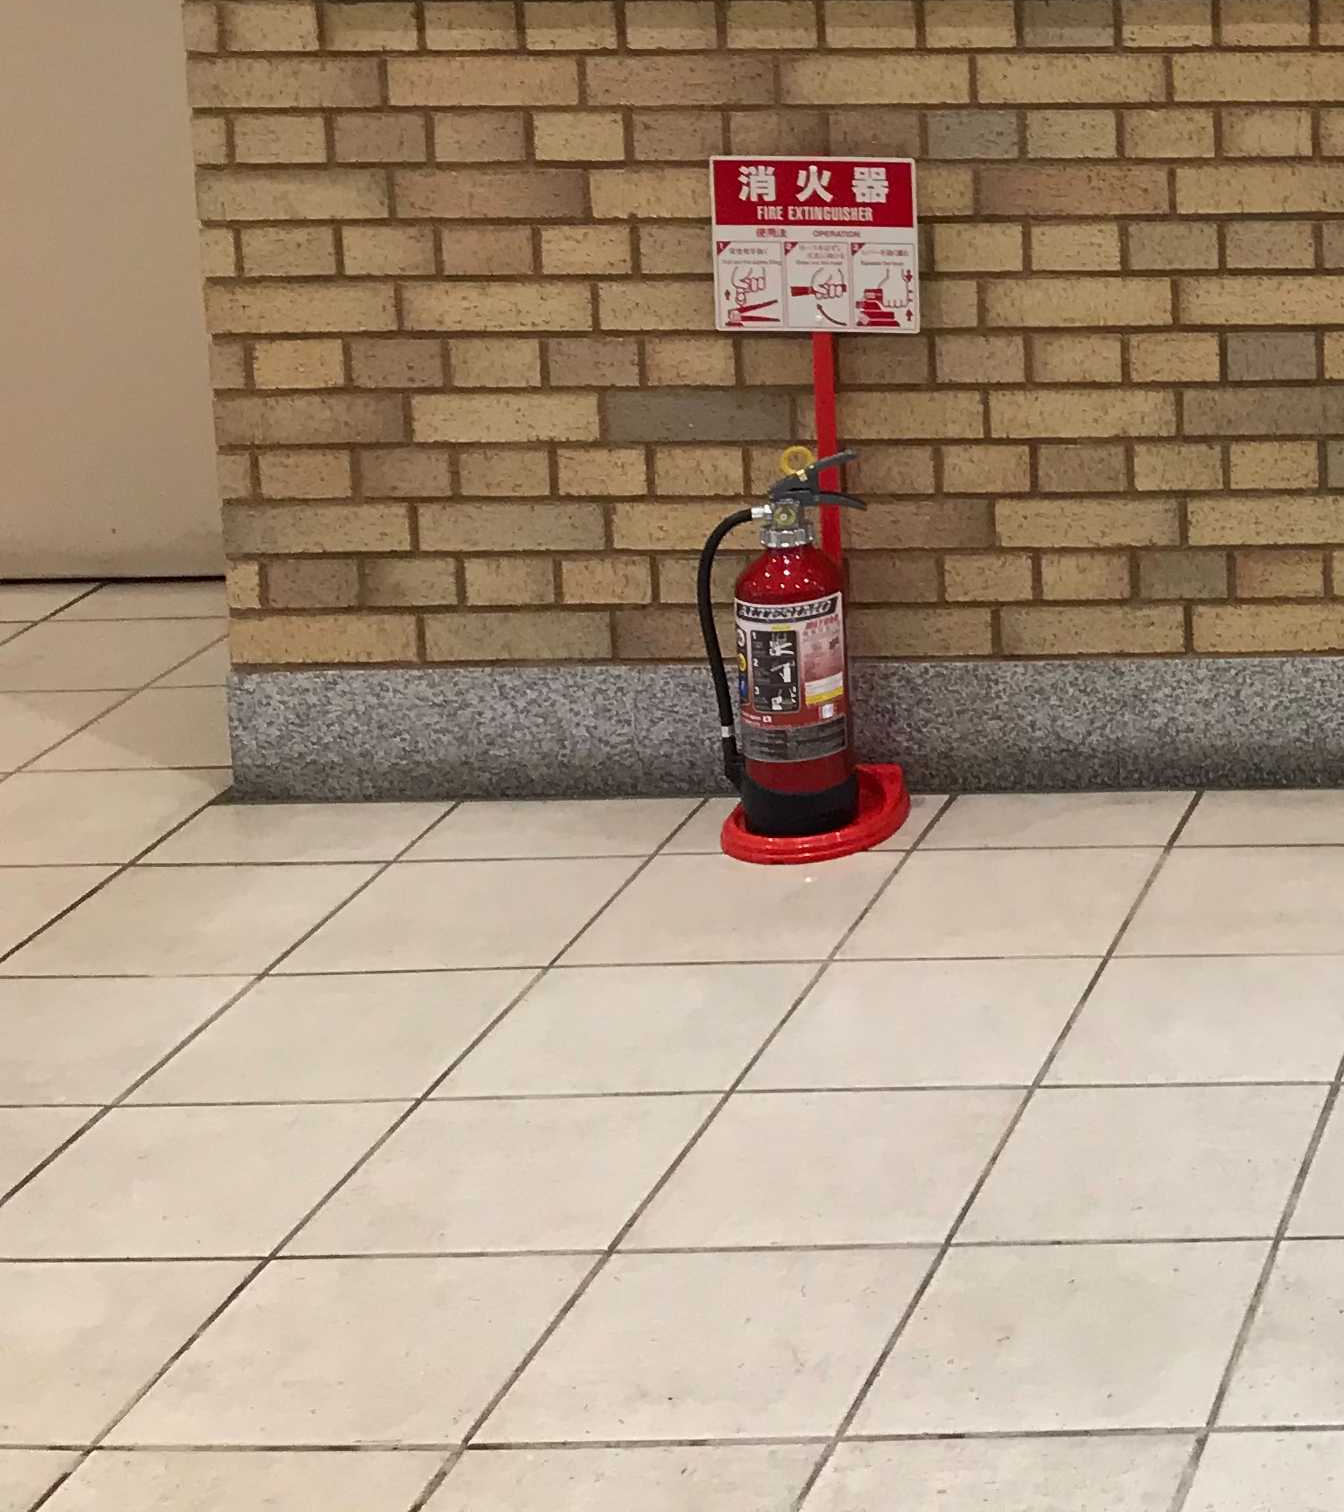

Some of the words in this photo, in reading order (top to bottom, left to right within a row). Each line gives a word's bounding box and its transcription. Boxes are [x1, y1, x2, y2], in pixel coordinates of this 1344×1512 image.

[738, 165, 890, 203] 消火器
[757, 205, 784, 221] FIRE
[788, 206, 873, 222] EXTINGUISHER
